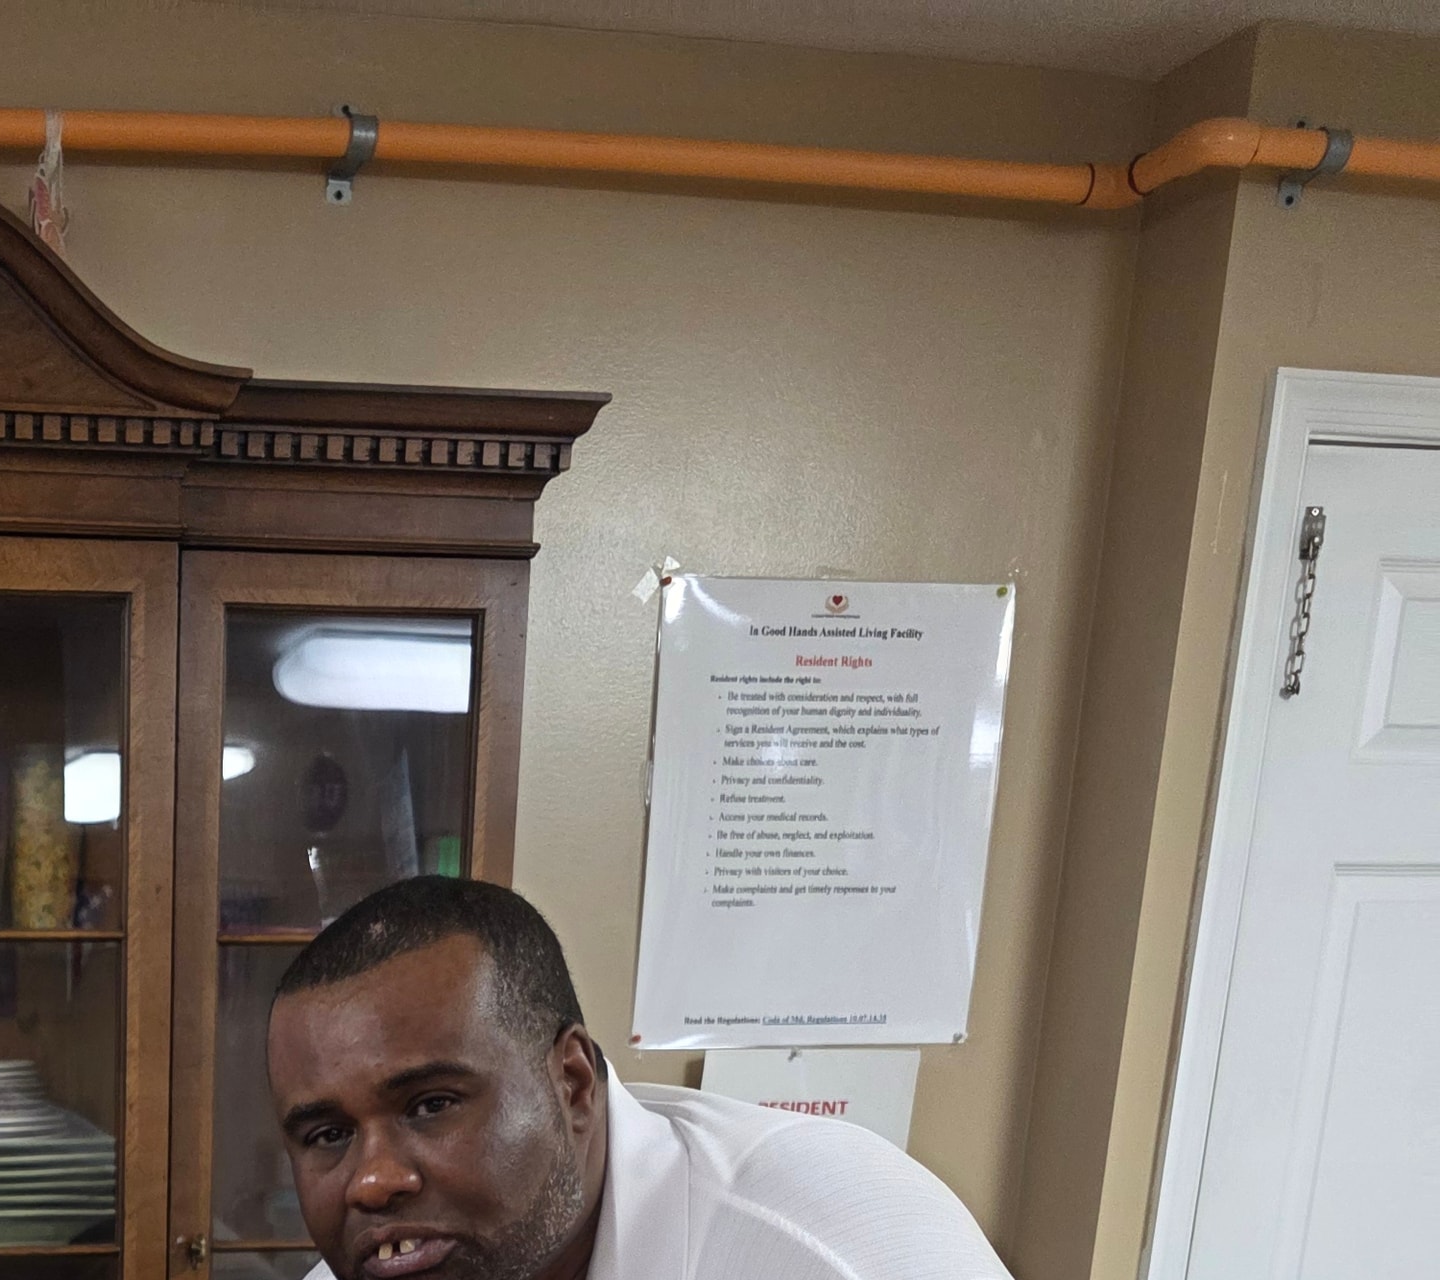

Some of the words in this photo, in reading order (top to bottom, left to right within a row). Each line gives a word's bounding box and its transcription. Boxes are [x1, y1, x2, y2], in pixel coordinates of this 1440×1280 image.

[750, 625, 759, 636] In
[762, 625, 786, 636] Good
[789, 626, 818, 637] Hands
[819, 627, 856, 637] Assisted
[859, 627, 888, 640] Living
[890, 628, 923, 641] Facility
[796, 655, 838, 667] Resident
[841, 656, 872, 669] Rights
[758, 1101, 848, 1115] SIDENT
